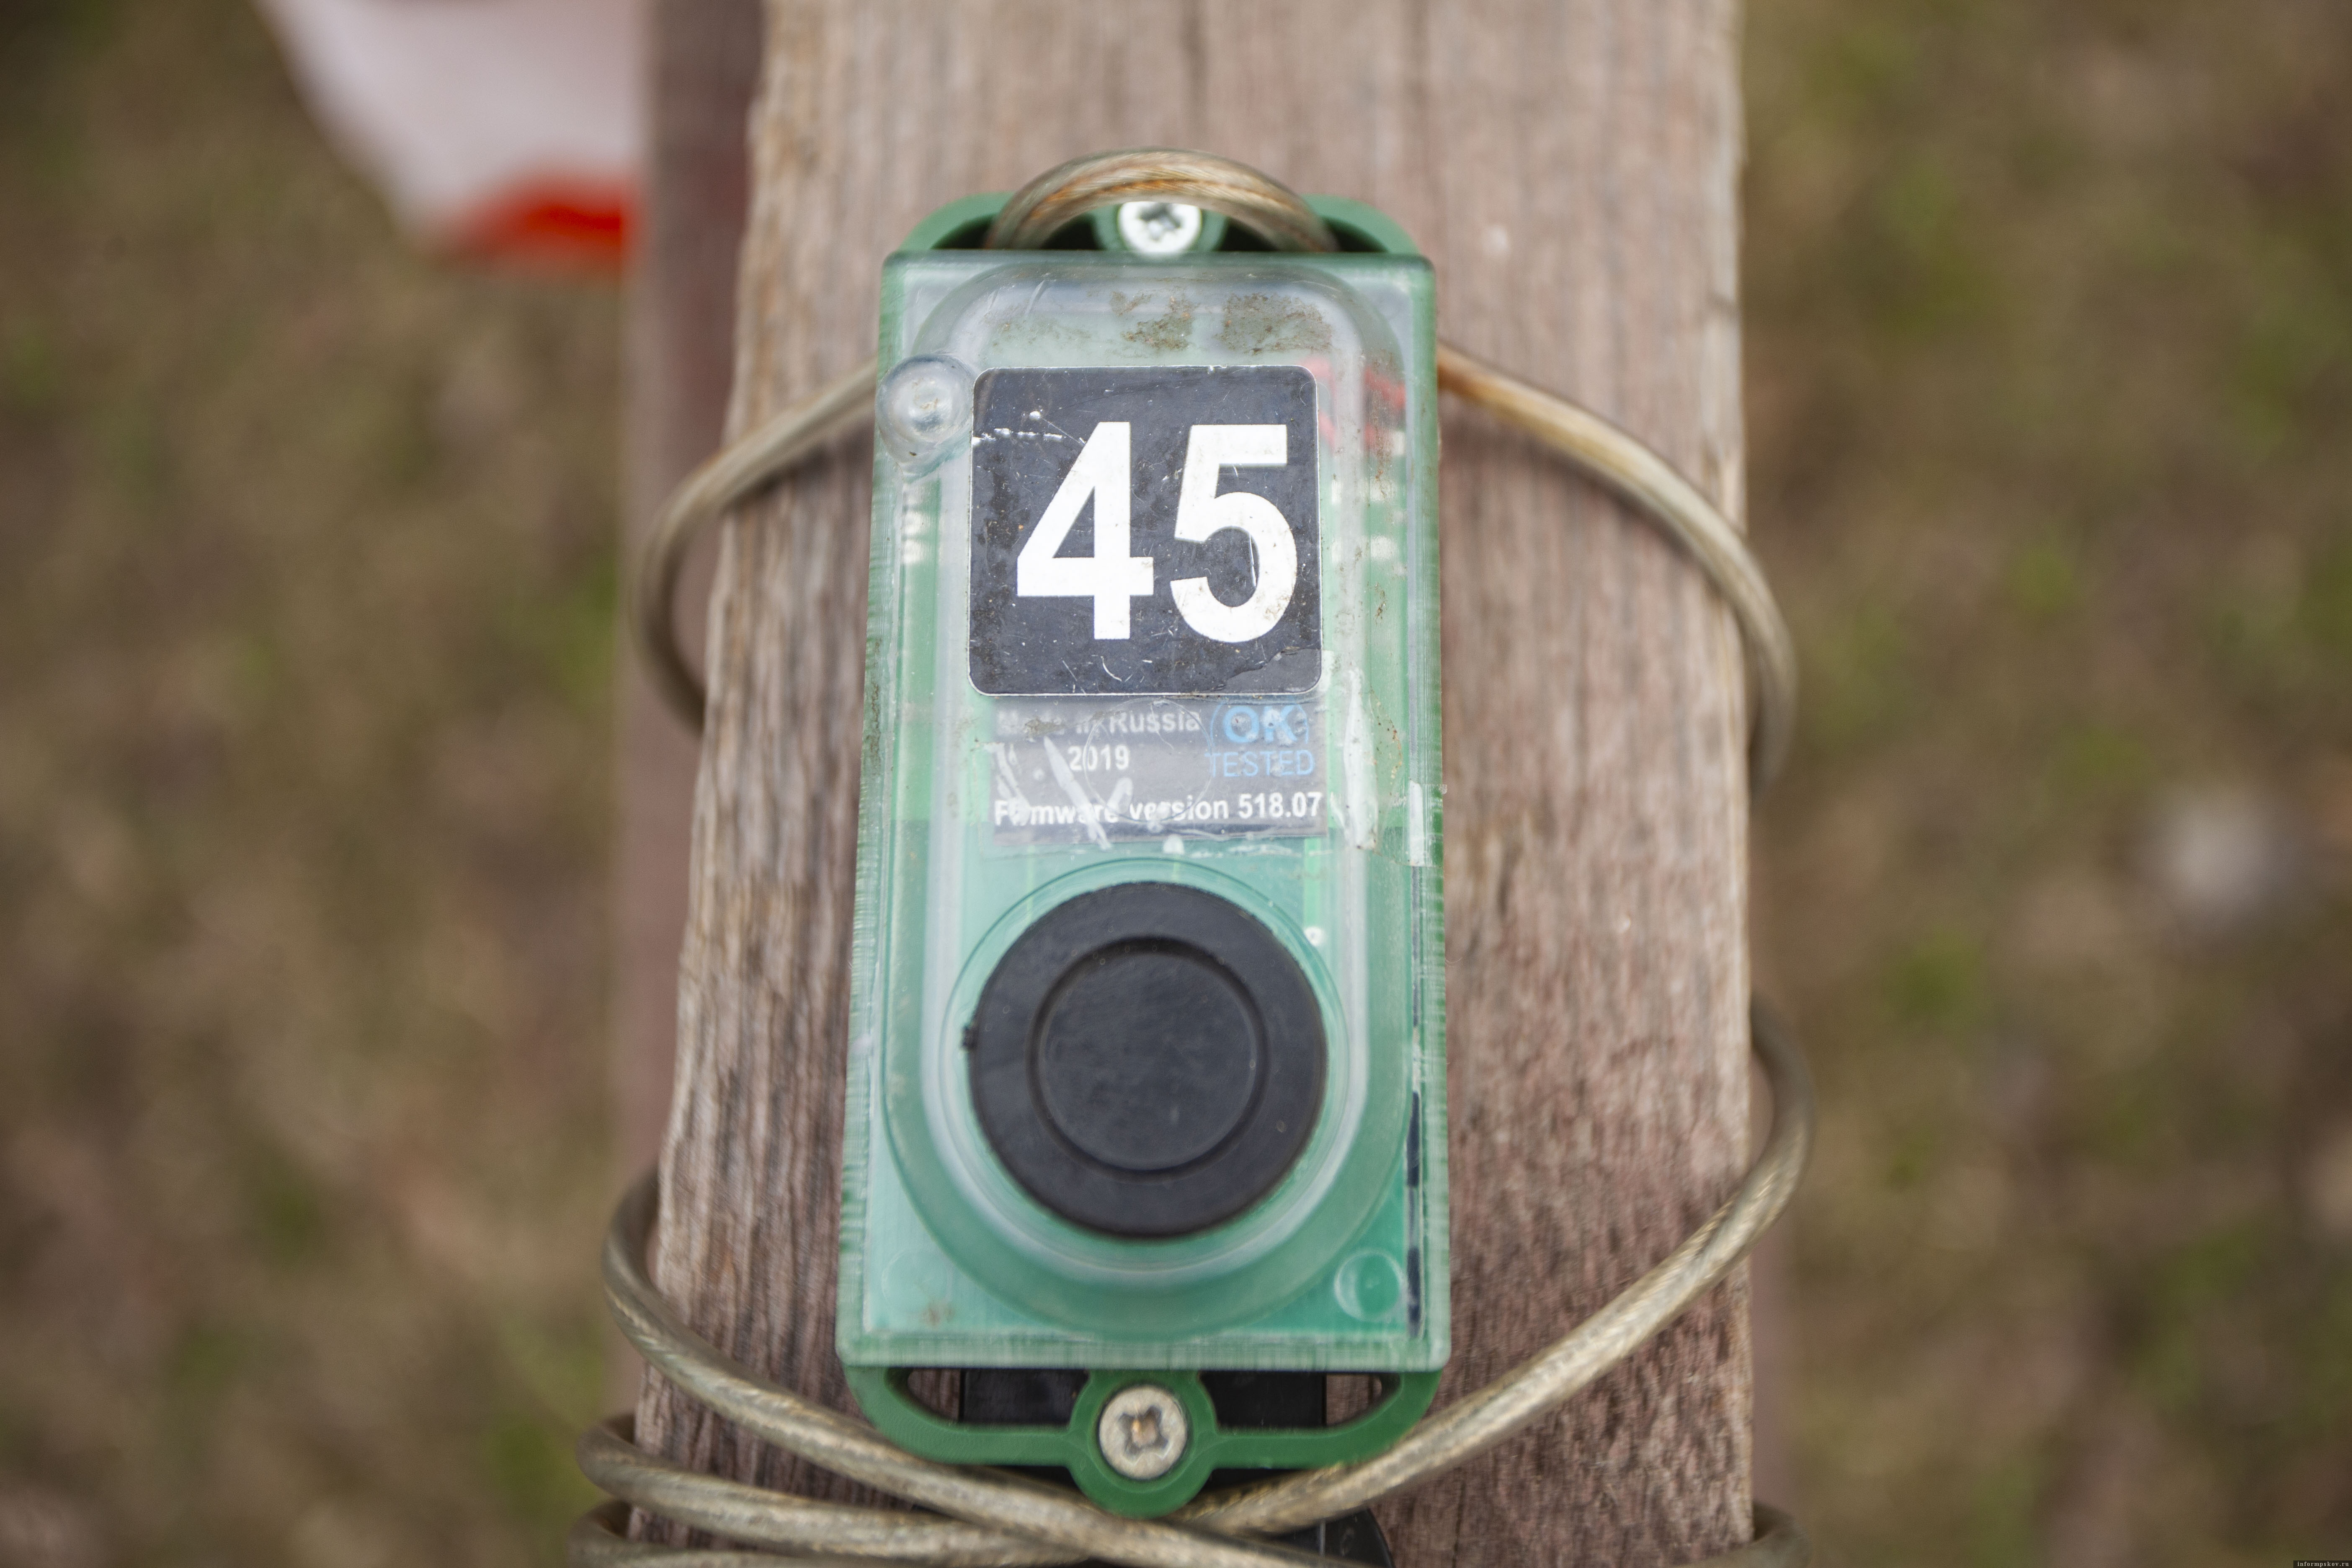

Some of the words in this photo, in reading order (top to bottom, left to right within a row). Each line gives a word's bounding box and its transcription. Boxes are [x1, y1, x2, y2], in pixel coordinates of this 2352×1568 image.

[1017, 422, 1297, 642] 45
[1109, 711, 1200, 734] Russia
[1068, 745, 1130, 771] 2019
[1205, 750, 1314, 777] TESTED
[1238, 791, 1323, 818] 518.07
